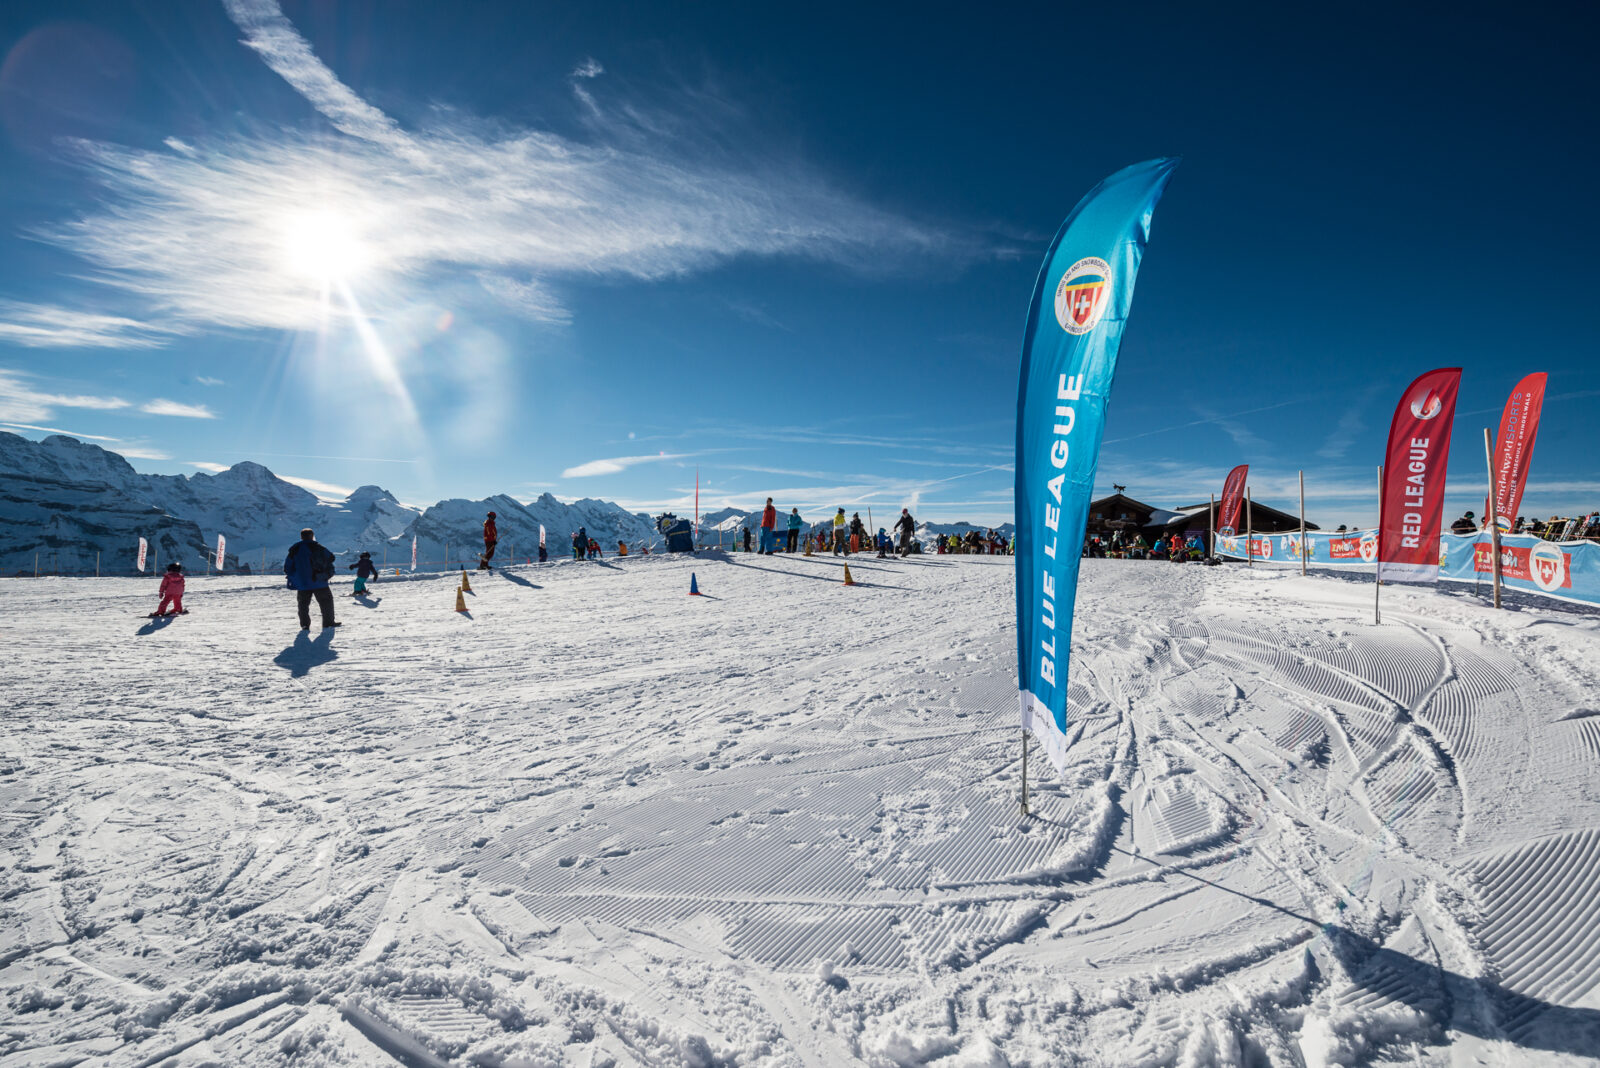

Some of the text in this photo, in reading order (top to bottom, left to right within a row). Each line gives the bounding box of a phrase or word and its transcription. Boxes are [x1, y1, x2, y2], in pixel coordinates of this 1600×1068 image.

[1044, 373, 1083, 560] LEAGUE
[1404, 437, 1430, 508] LEAGUE
[1507, 392, 1531, 515] SCHWEIZER SKISCHULE GRINDELWALD
[1401, 515, 1422, 549] RED
[1040, 571, 1056, 689] BLUE
